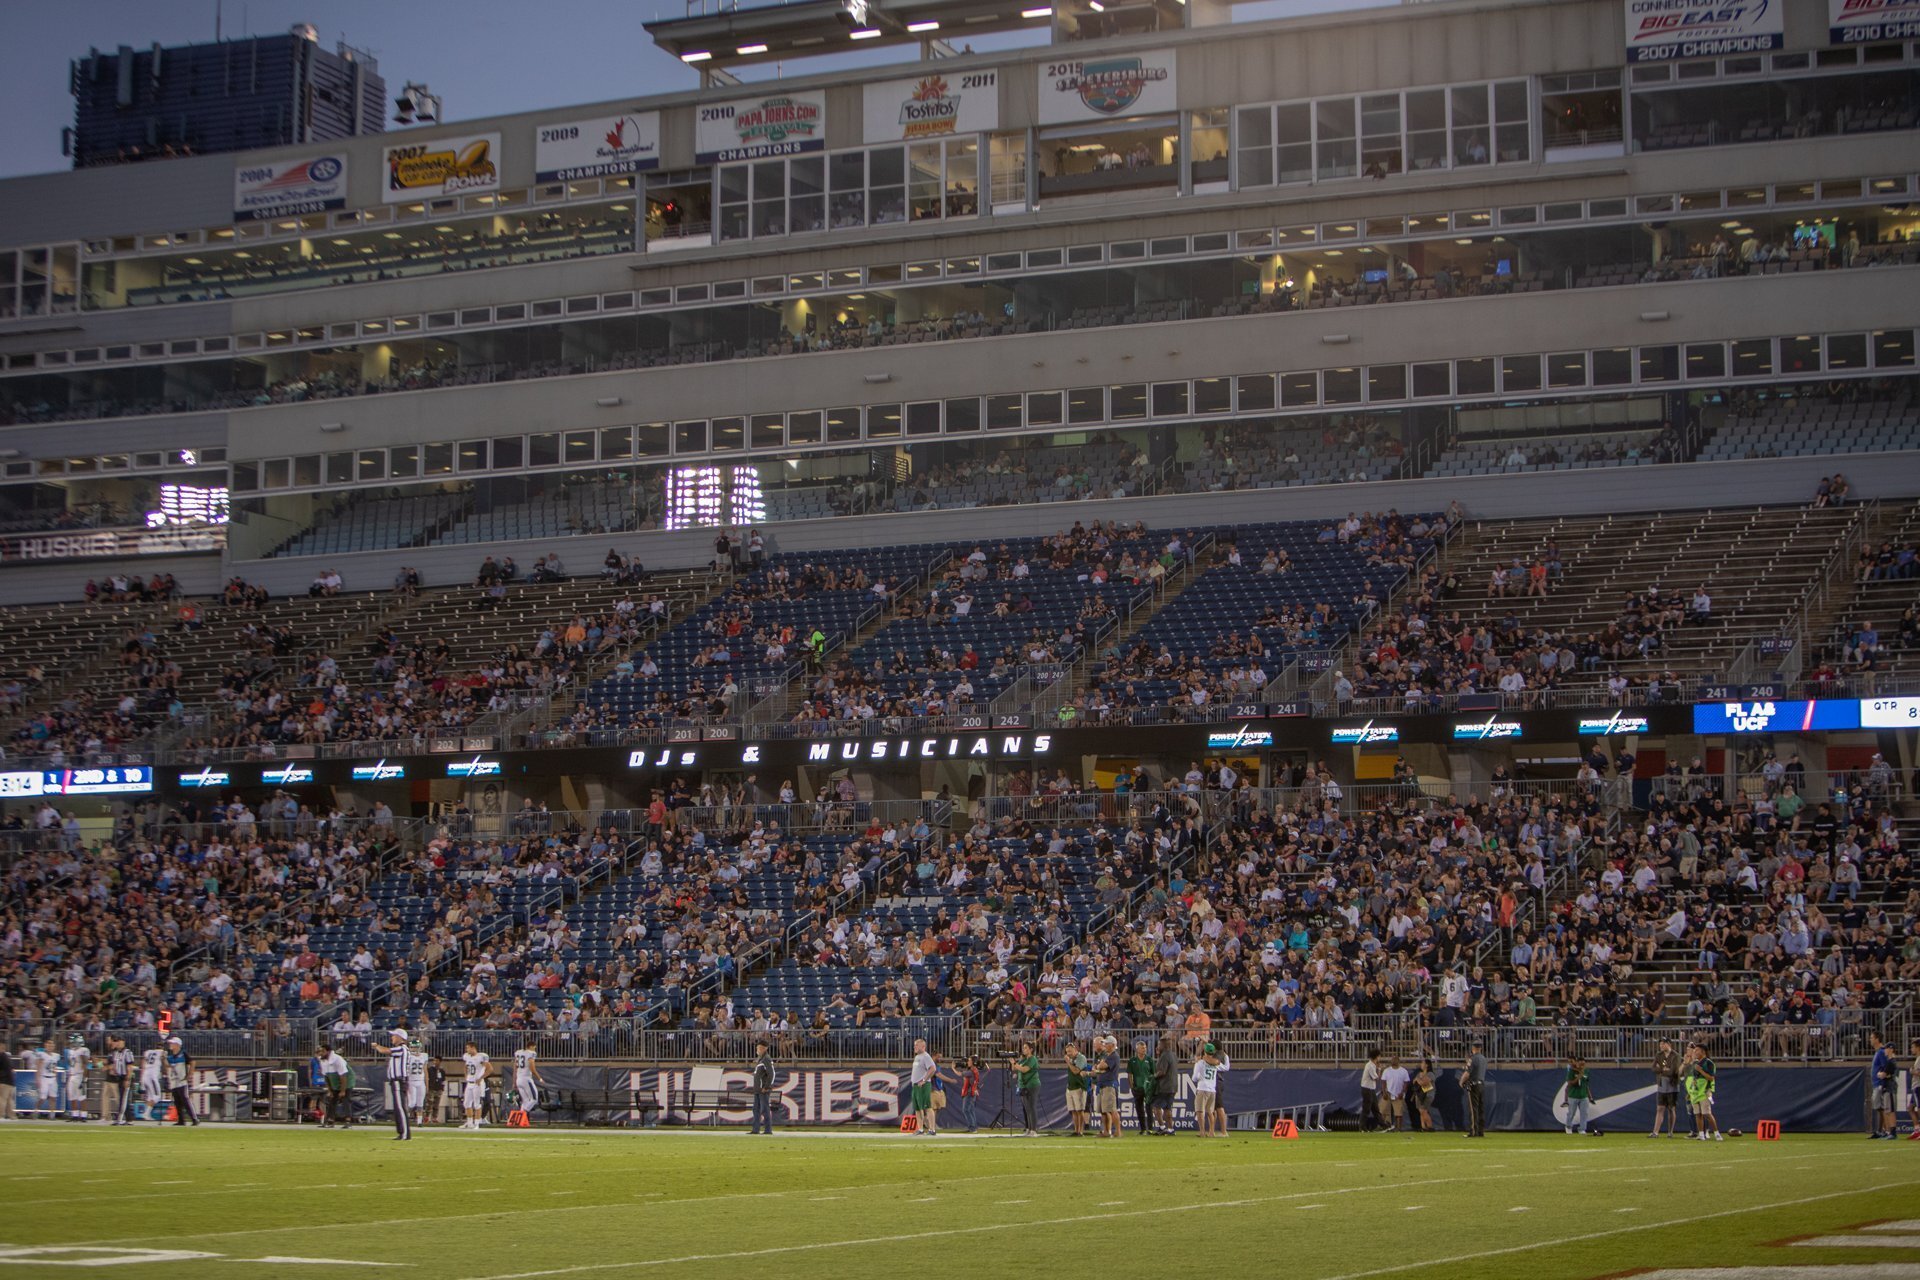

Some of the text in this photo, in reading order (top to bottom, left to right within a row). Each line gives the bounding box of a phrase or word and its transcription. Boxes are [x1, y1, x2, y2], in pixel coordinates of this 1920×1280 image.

[1640, 8, 1747, 30] BIG EAST
[1677, 26, 1744, 39] FOOTBALL
[1843, 23, 1920, 42] 2010 CHA
[1638, 36, 1772, 61] 2007 CHAMPIONS
[1048, 62, 1083, 77] 2015
[962, 73, 995, 89] 2011
[702, 106, 734, 122] 2010
[541, 126, 579, 142] 2009
[907, 120, 953, 134] FIESTA BOWL
[388, 145, 427, 161] 2007
[718, 142, 801, 161] CHAMPIONS
[241, 168, 273, 184] 2004
[557, 161, 637, 180] CHAMPIONS
[443, 173, 497, 193] BOWL
[252, 201, 326, 219] CHAMPIONS
[20, 532, 119, 560] HUSKIES
[1706, 687, 1728, 698] 241
[1751, 686, 1773, 697] 240
[1236, 705, 1257, 716] 242
[1277, 704, 1297, 715] 241
[1874, 701, 1898, 711] QTR
[963, 717, 982, 727] 200
[1000, 715, 1020, 726] 242
[1733, 716, 1769, 731] UCF
[675, 729, 692, 739] 201
[710, 728, 728, 738] 200
[437, 740, 454, 750] 202
[470, 739, 486, 748] 201
[742, 746, 760, 762] &
[808, 735, 1051, 760] MUSICIANS
[1450, 982, 1456, 992] 6
[158, 1010, 171, 1032] 2
[981, 1031, 991, 1039] 140
[1440, 1030, 1451, 1038] 139
[1810, 1027, 1821, 1035] 139
[411, 1062, 423, 1075] 25
[1205, 1068, 1215, 1081] 51
[510, 1112, 523, 1125] 40
[902, 1116, 917, 1131] 30
[1274, 1121, 1290, 1137] 20
[1760, 1121, 1777, 1139] 10
